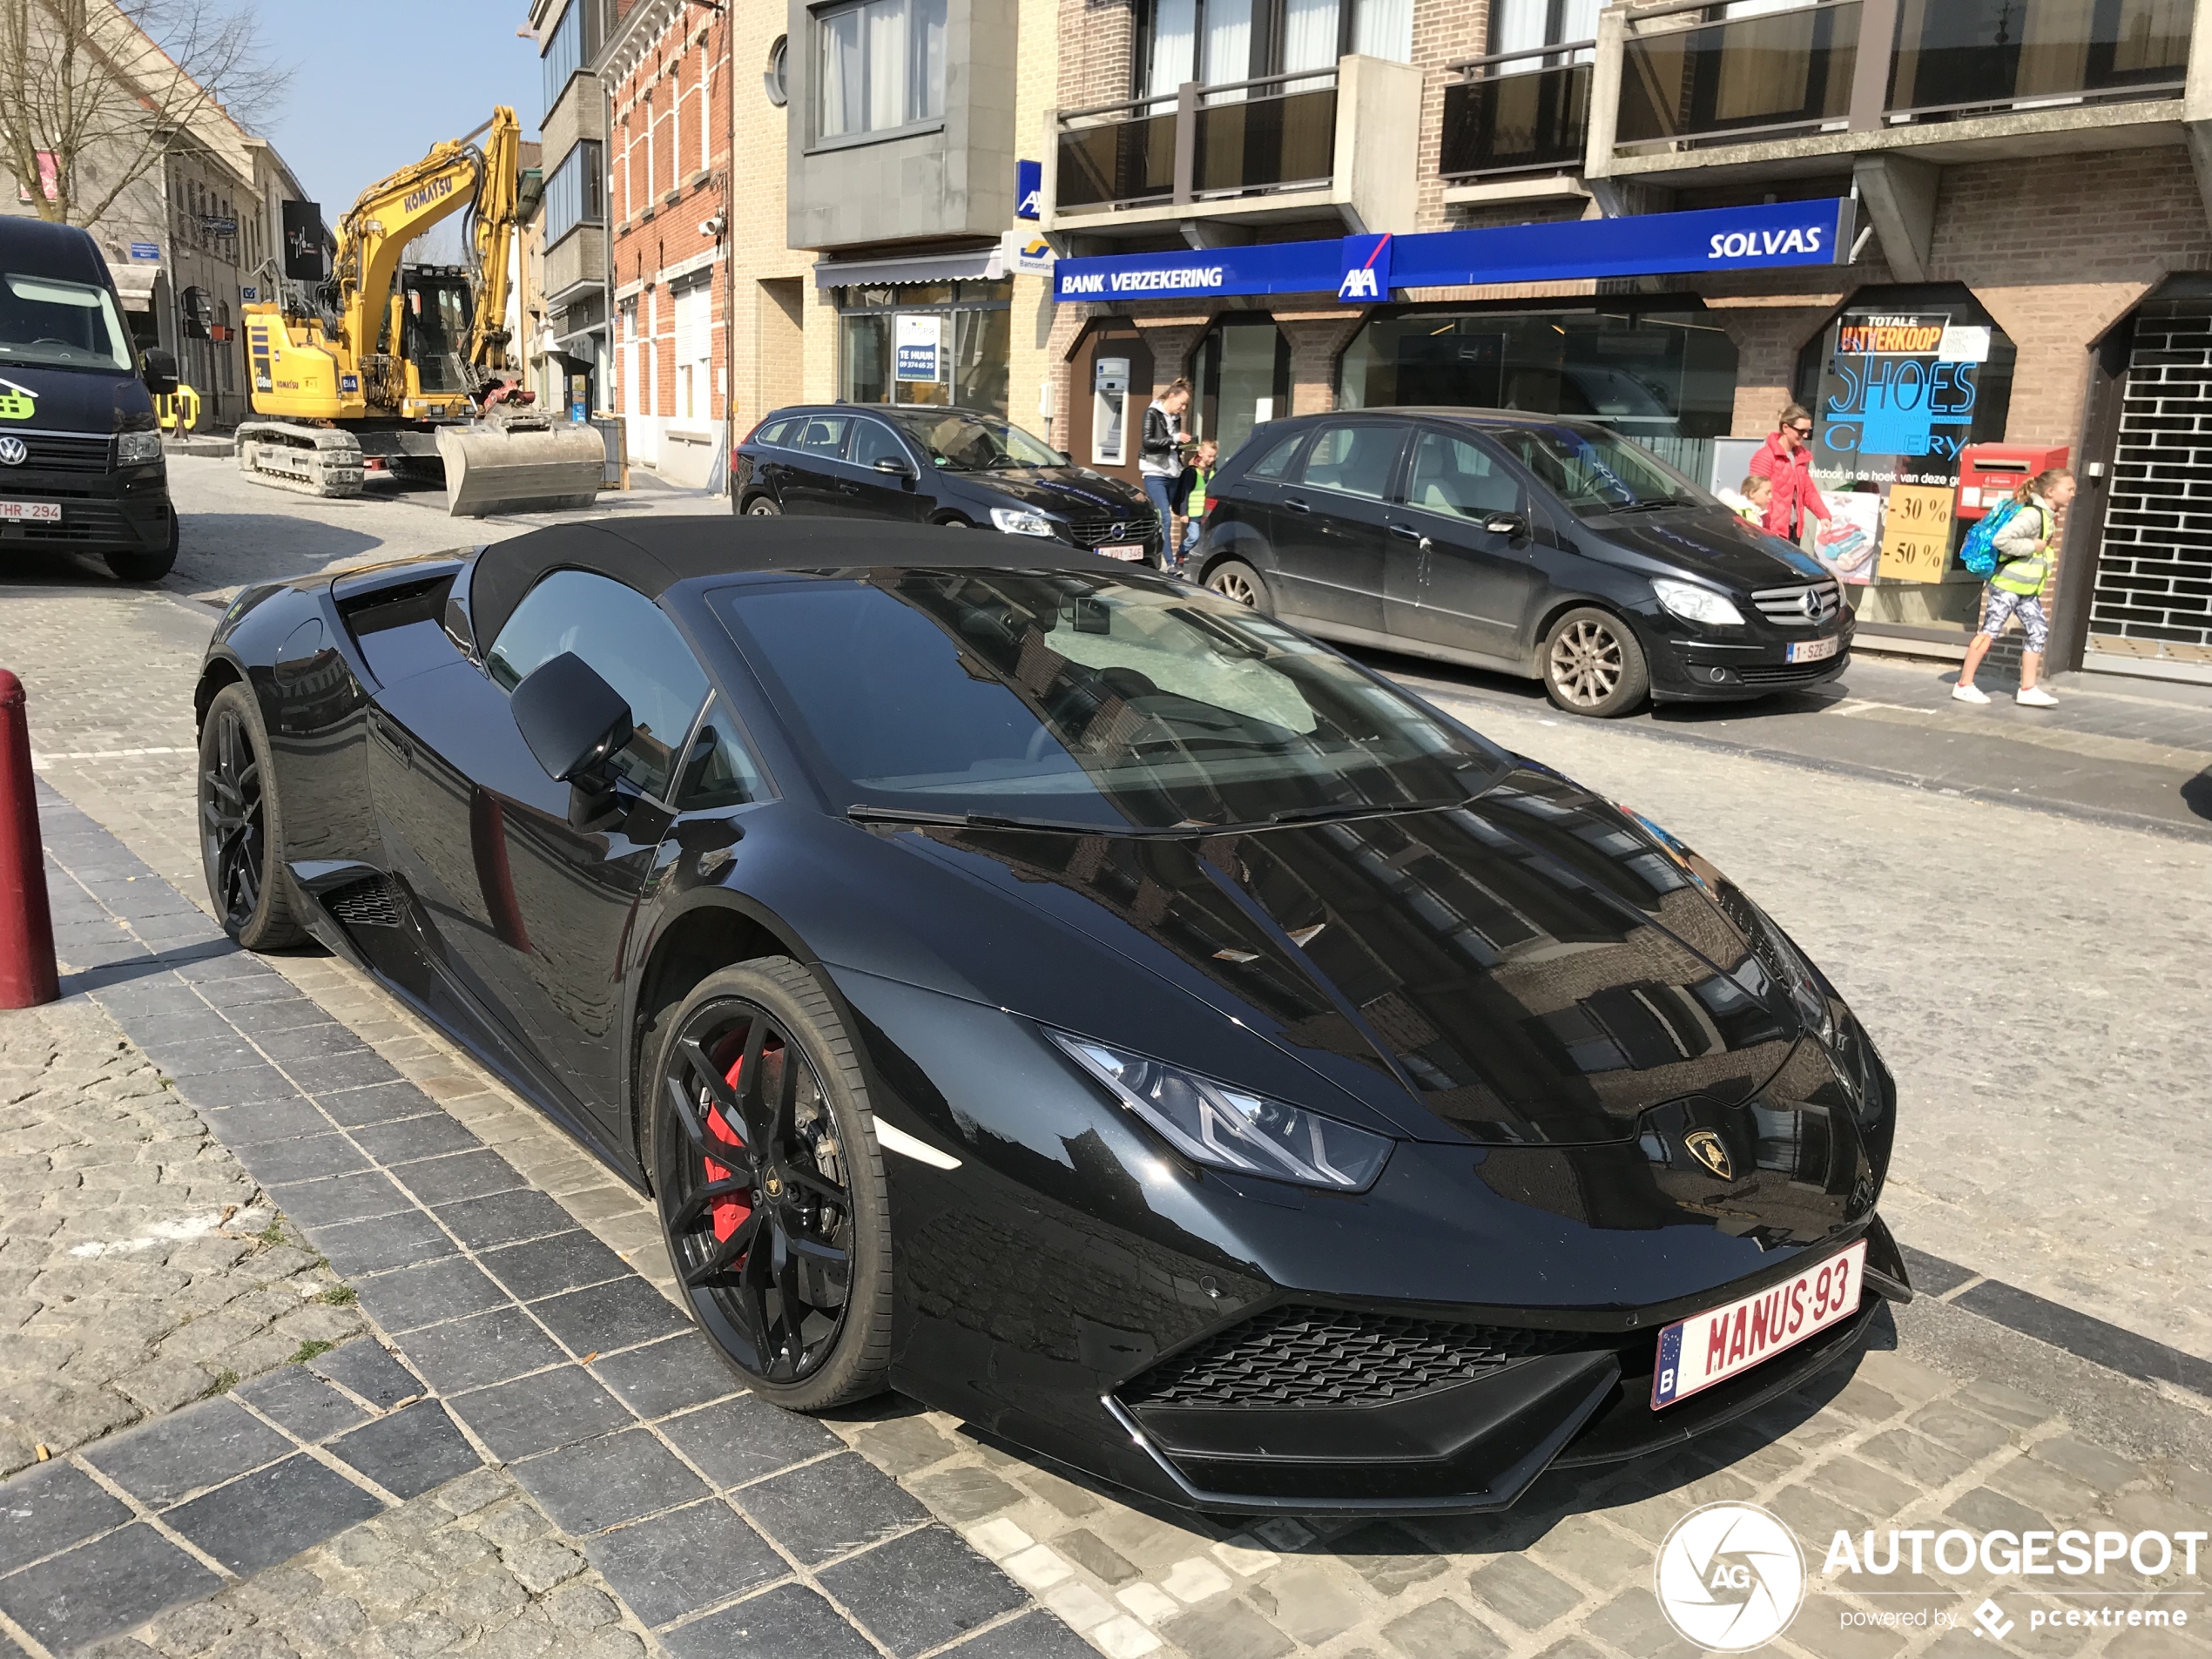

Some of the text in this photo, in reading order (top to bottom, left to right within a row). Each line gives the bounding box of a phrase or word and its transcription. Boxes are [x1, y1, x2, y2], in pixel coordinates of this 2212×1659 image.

[404, 176, 452, 213] KOMATSU
[1708, 227, 1822, 259] SOLVAS
[1062, 267, 1223, 293] BANK VERZEKERING
[1339, 268, 1378, 297] AXA
[1867, 316, 1919, 327] TOTALE
[1841, 326, 1941, 352] UITVERKOOP
[900, 350, 934, 361] TE HUUR
[276, 380, 299, 389] KOMATSU
[1829, 333, 1978, 413] SHOES
[1845, 469, 1854, 479] in
[1856, 470, 1870, 481] de
[1871, 471, 1897, 482] hoek
[1900, 474, 1919, 483] van
[1920, 473, 1946, 484] deze
[1900, 497, 1922, 520] 30
[1929, 499, 1947, 523] %
[1895, 542, 1916, 564] 50
[1923, 544, 1940, 568] %
[1660, 1368, 1674, 1394] B
